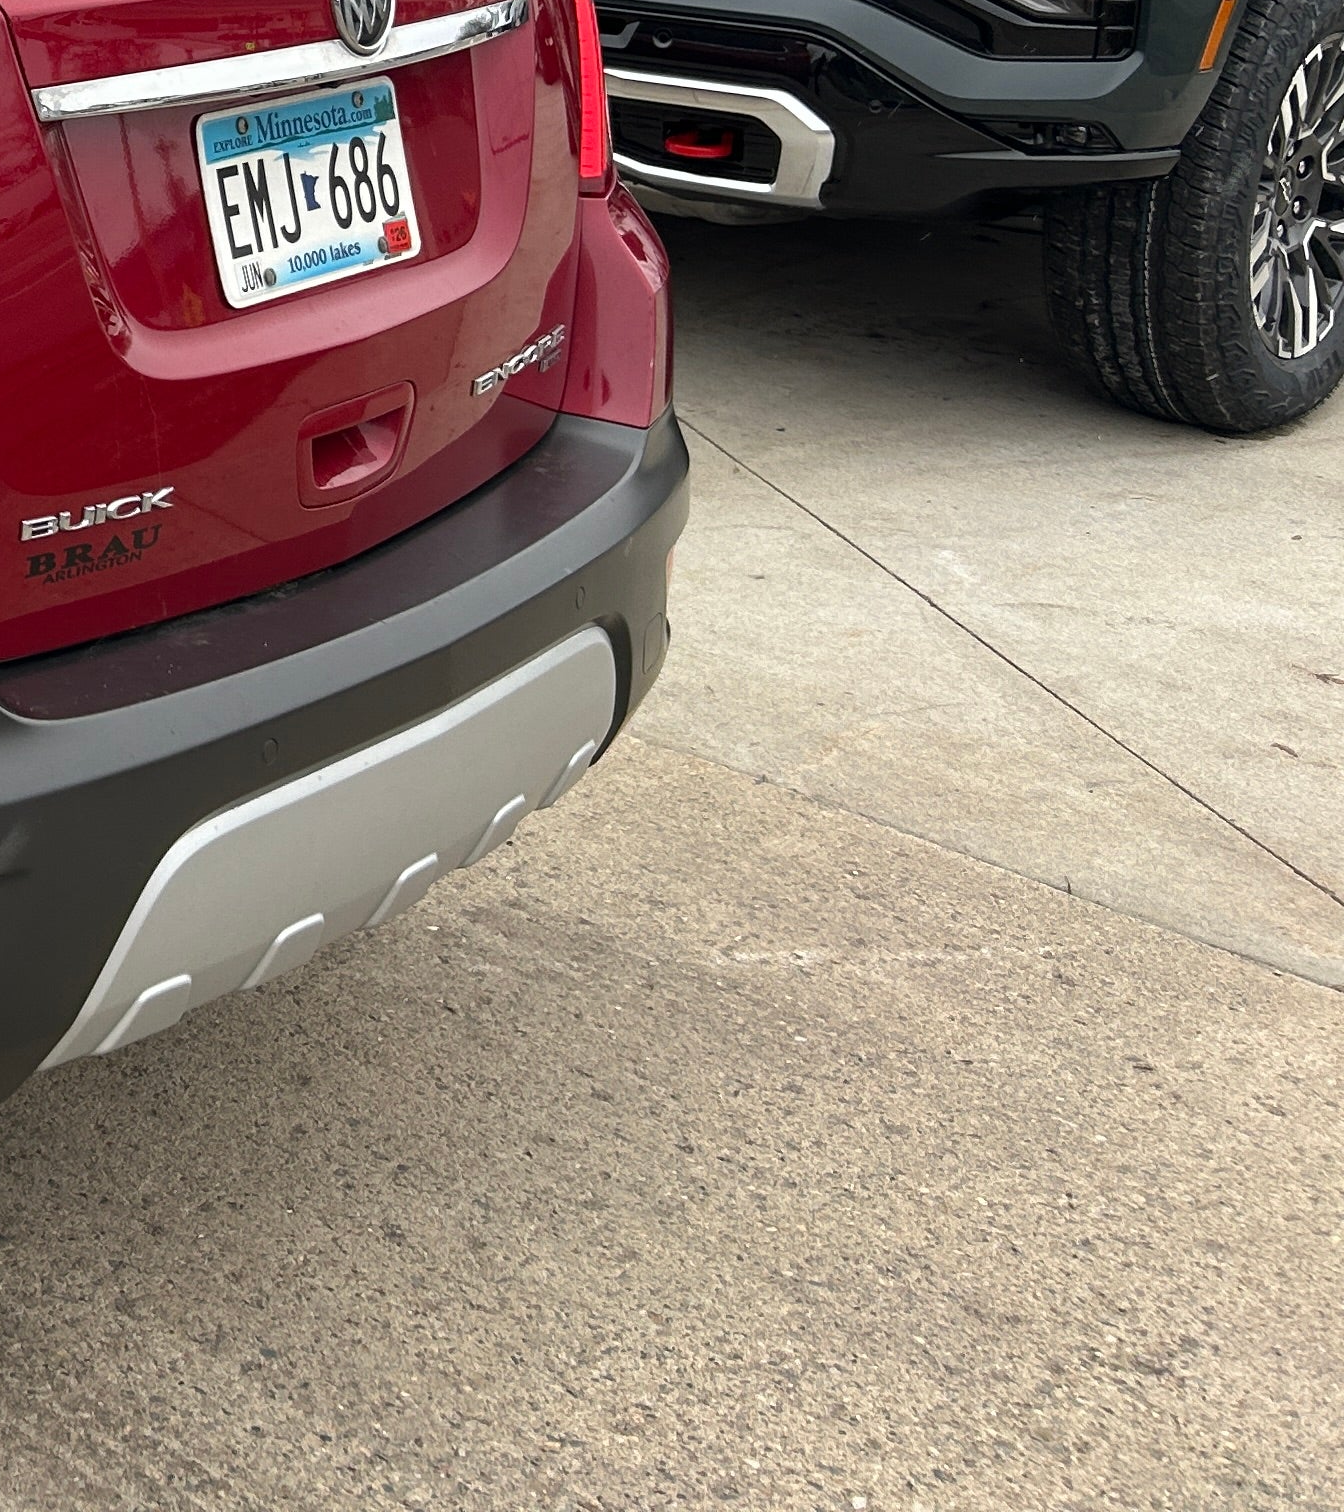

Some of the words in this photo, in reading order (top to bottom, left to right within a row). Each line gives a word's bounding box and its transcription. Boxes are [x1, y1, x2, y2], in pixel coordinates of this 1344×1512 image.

[213, 135, 253, 153] EXPLORE
[254, 105, 372, 143] Minnesota.com
[216, 152, 302, 259] EMJ
[329, 131, 400, 229] 686
[241, 262, 263, 292] JUN
[288, 250, 327, 274] 10,000
[330, 241, 362, 263] lakes
[20, 486, 175, 542] BUICK
[25, 524, 162, 579] BRAU
[42, 550, 142, 585] ARLINGTON
